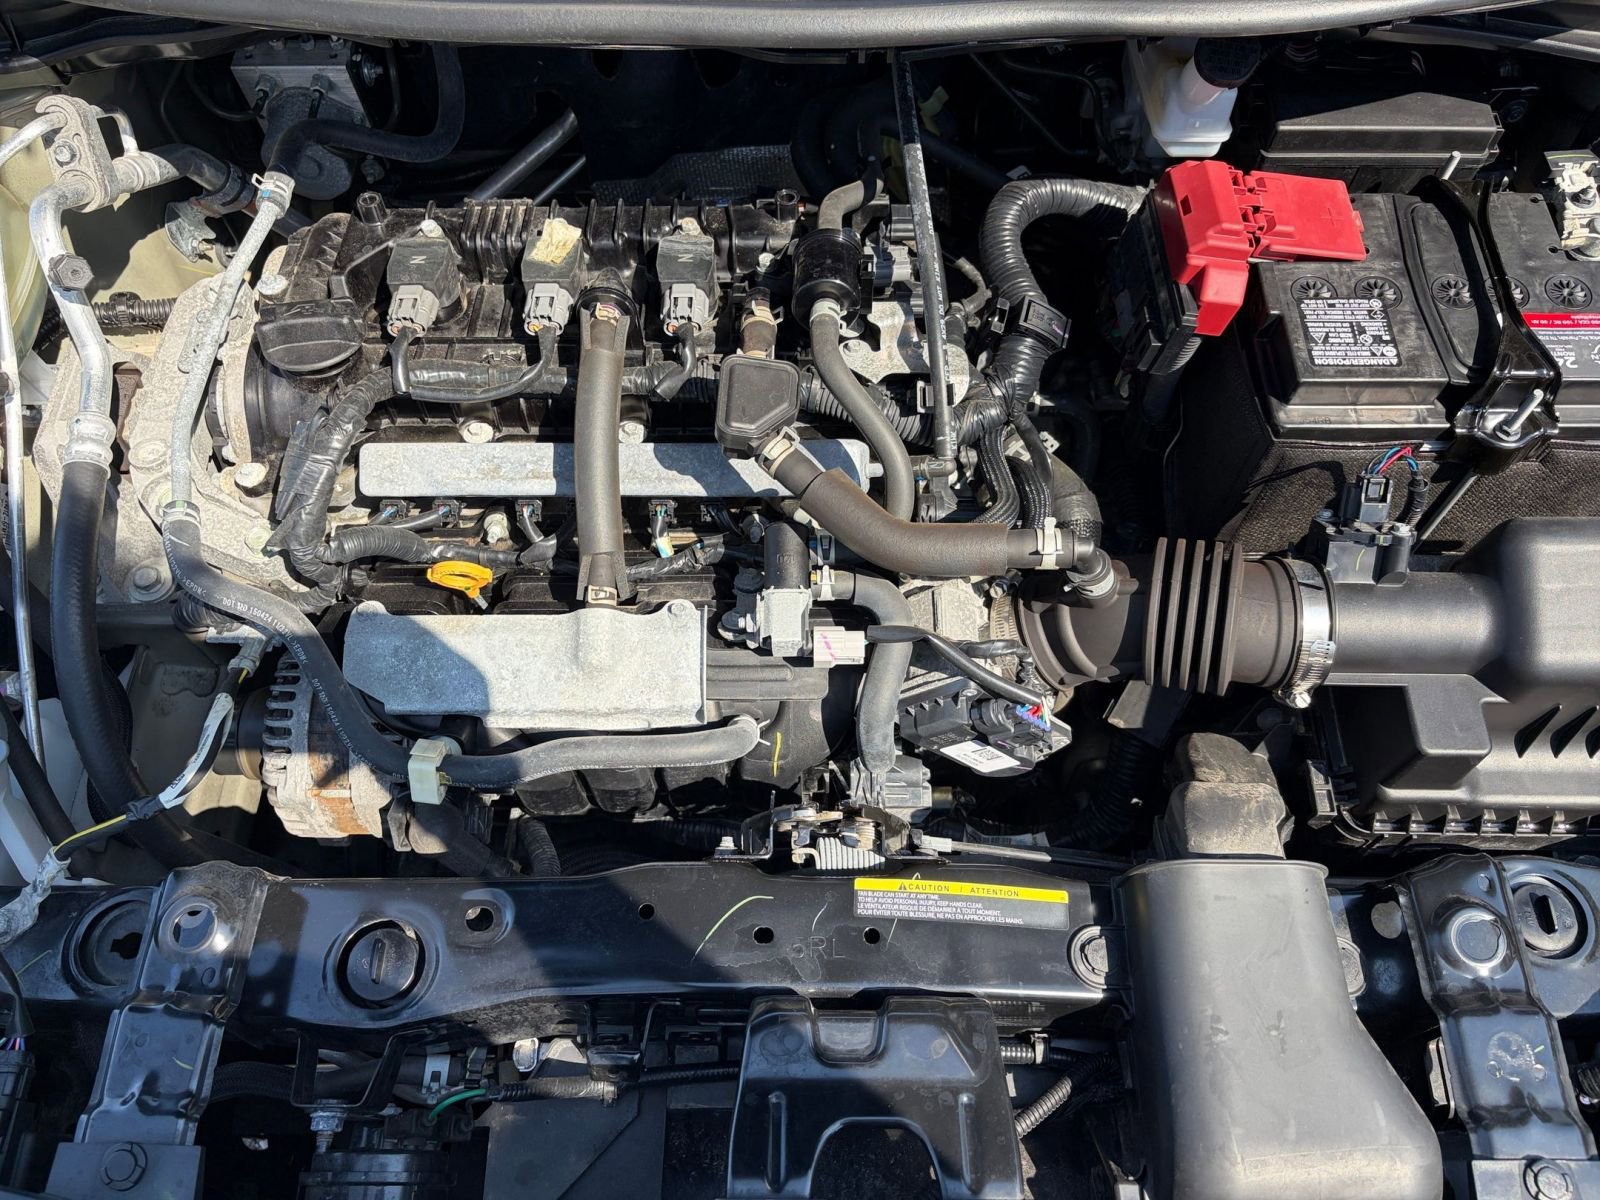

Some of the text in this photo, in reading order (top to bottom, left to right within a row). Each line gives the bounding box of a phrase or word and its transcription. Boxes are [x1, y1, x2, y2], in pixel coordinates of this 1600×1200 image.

[222, 597, 236, 608] DOT
[250, 606, 273, 623] 150424
[908, 884, 950, 892] CAUTION
[970, 888, 1019, 897] ATTENTION
